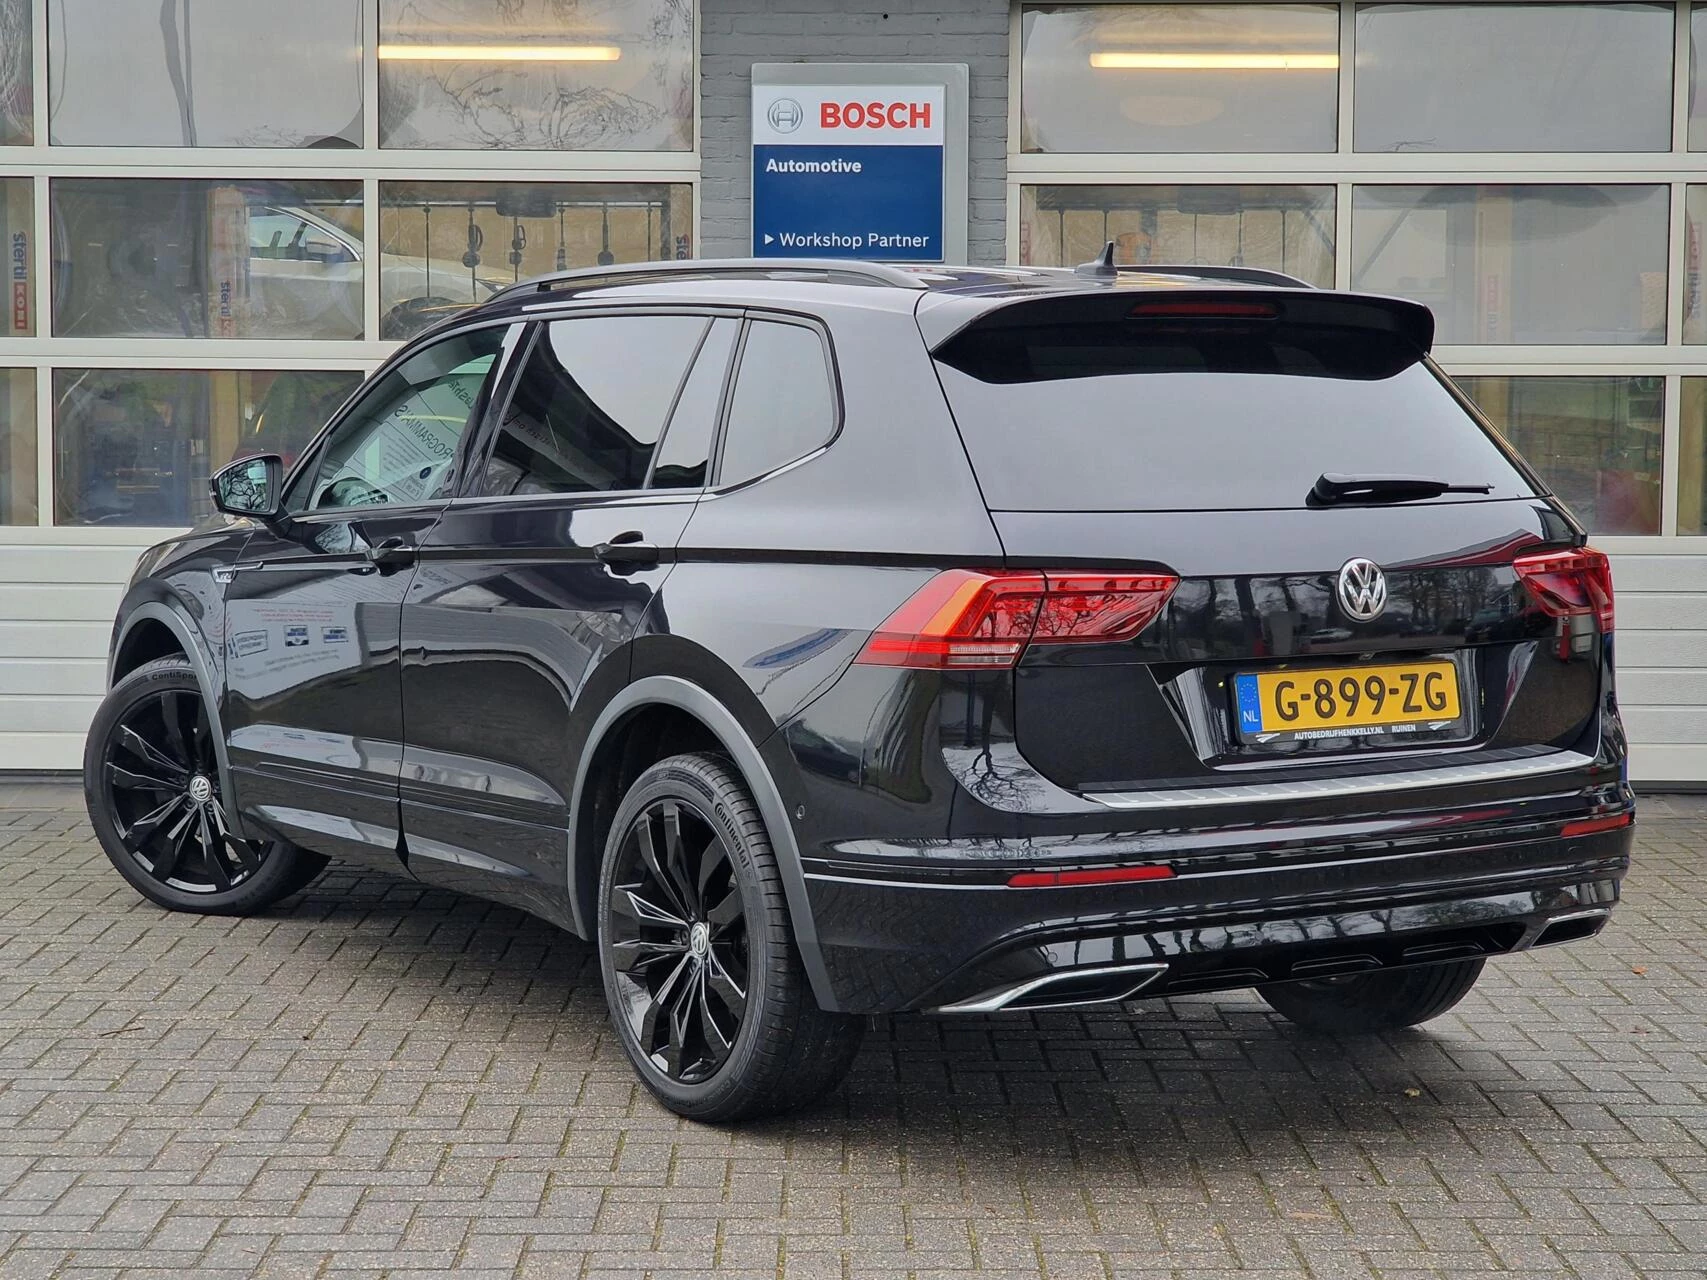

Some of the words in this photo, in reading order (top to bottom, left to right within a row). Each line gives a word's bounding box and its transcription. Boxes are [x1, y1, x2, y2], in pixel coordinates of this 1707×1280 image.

[820, 102, 931, 128] BOSCH
[765, 158, 862, 173] Automotive
[779, 233, 862, 249] Workshop
[868, 233, 929, 247] Partner
[13, 231, 27, 280] stertil
[151, 671, 197, 681] ContiSpor
[1275, 671, 1447, 721] G-899-ZG
[1243, 710, 1259, 723] NL
[714, 802, 750, 869] Continental
